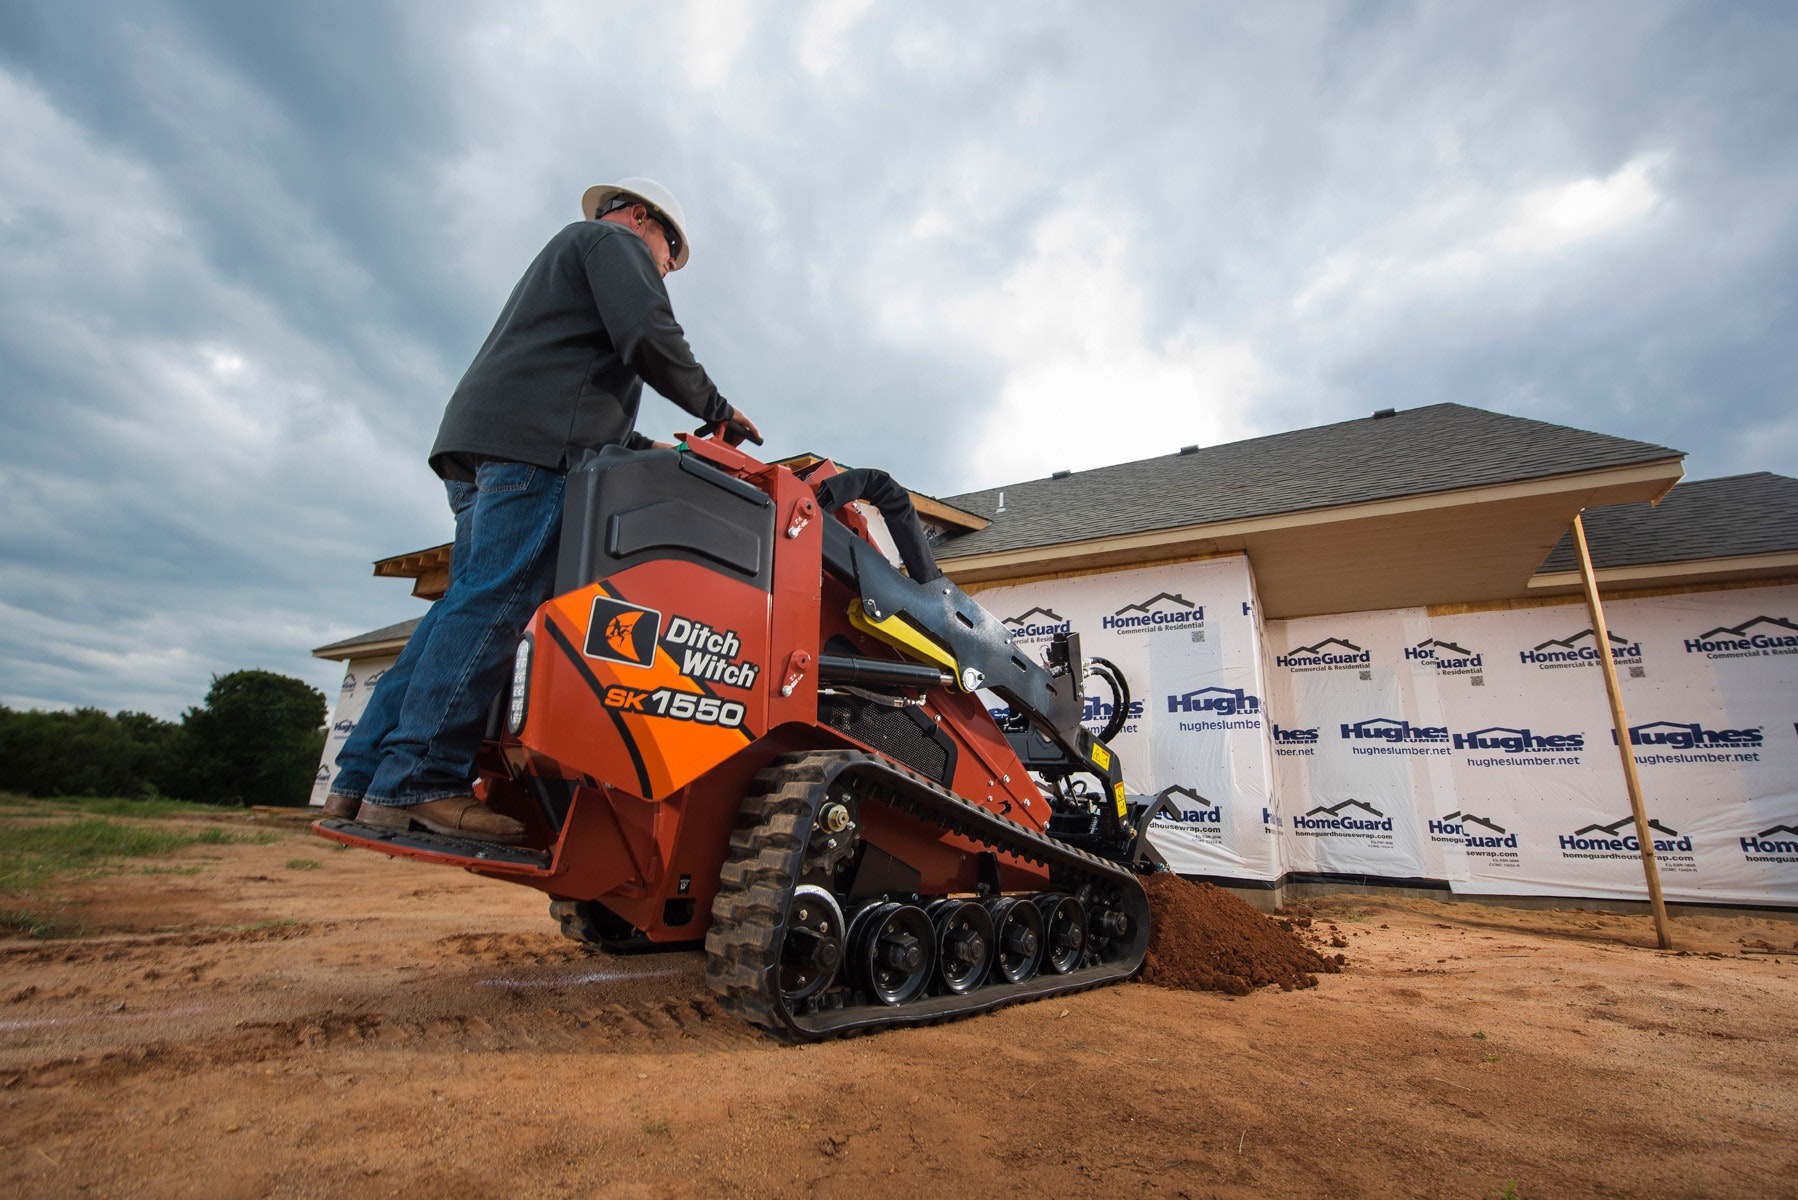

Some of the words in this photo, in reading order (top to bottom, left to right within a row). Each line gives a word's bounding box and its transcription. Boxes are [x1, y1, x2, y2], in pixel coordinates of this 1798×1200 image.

[1102, 605, 1205, 630] HomeGuard
[1011, 620, 1070, 638] eGuard
[1116, 625, 1157, 636] Commercial
[1164, 621, 1205, 631] Residential
[665, 617, 740, 657] Ditch
[1684, 634, 1798, 653] HomeGua
[1276, 650, 1371, 667] HomeGuard
[1706, 650, 1760, 660] Commercial
[682, 649, 757, 688] Witch
[1290, 665, 1327, 673] Commercial
[1334, 662, 1371, 671] Residential
[1442, 667, 1483, 676] Residential
[1539, 661, 1586, 670] Commercial
[1168, 687, 1259, 716] Hugh
[1179, 719, 1261, 732] hugheslumbe
[1273, 724, 1319, 740] hes
[1452, 727, 1585, 753] Hughes
[1352, 746, 1452, 756] hugheslumber.net
[1467, 756, 1581, 768] hugheslumber.net
[1149, 822, 1221, 833] dhousewrap.com
[1293, 816, 1393, 831] HomeGuard
[1295, 831, 1393, 840] homeguardhousewrap.com
[1559, 835, 1693, 852] HomeGard
